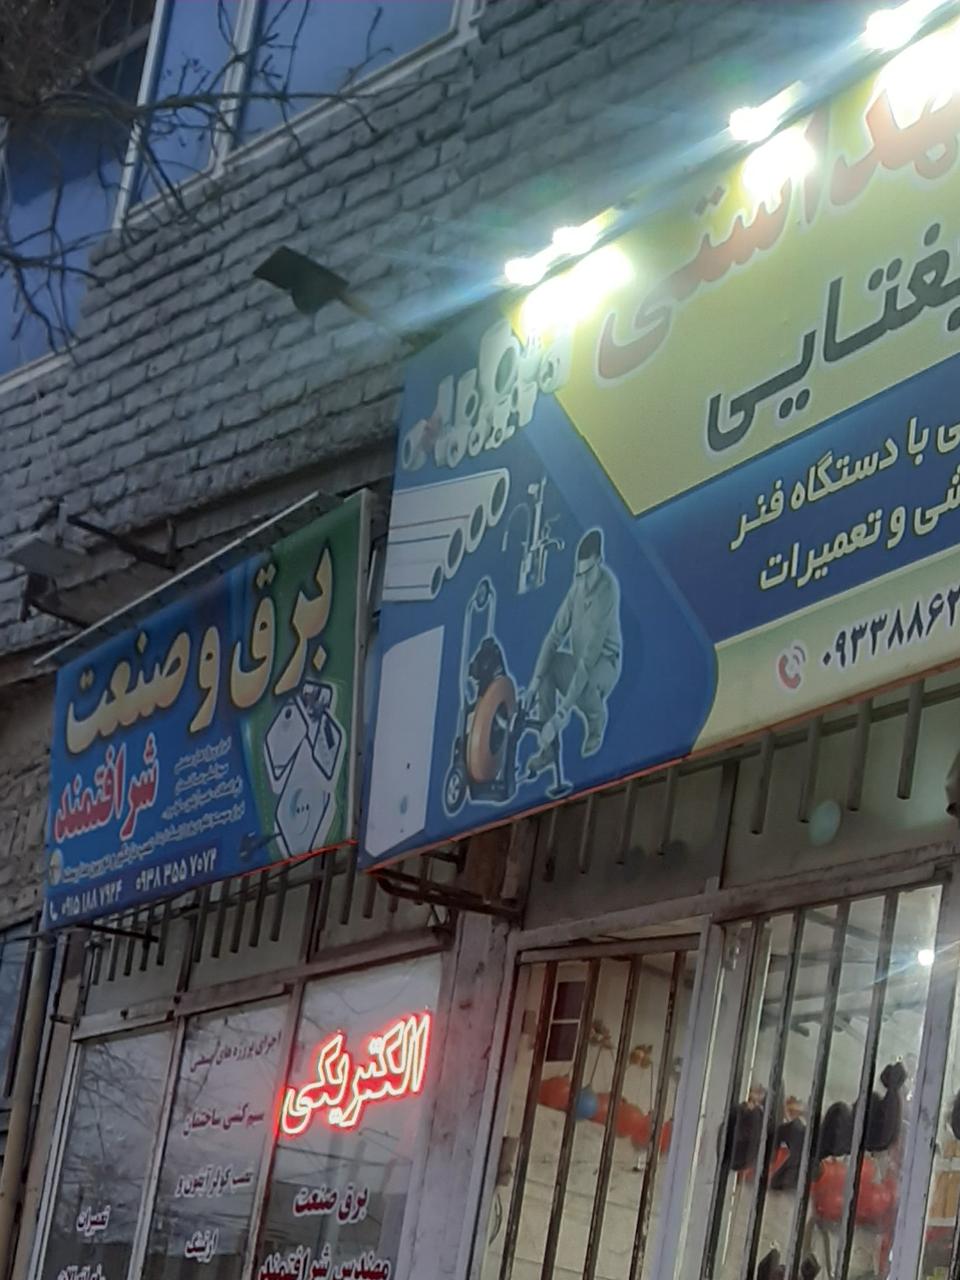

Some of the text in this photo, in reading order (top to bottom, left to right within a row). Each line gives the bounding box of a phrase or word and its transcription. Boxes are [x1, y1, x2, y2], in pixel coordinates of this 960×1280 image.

[789, 436, 899, 506] دستگاه
[907, 417, 930, 460] با
[730, 480, 784, 550] فنر
[758, 507, 881, 592] تعمیرات
[886, 503, 906, 550] و
[65, 544, 336, 756] برق و صنعت
[54, 732, 160, 843] شرافتمند
[282, 1014, 430, 1134] الکتریکی
[293, 1181, 369, 1223] برق صنعت
